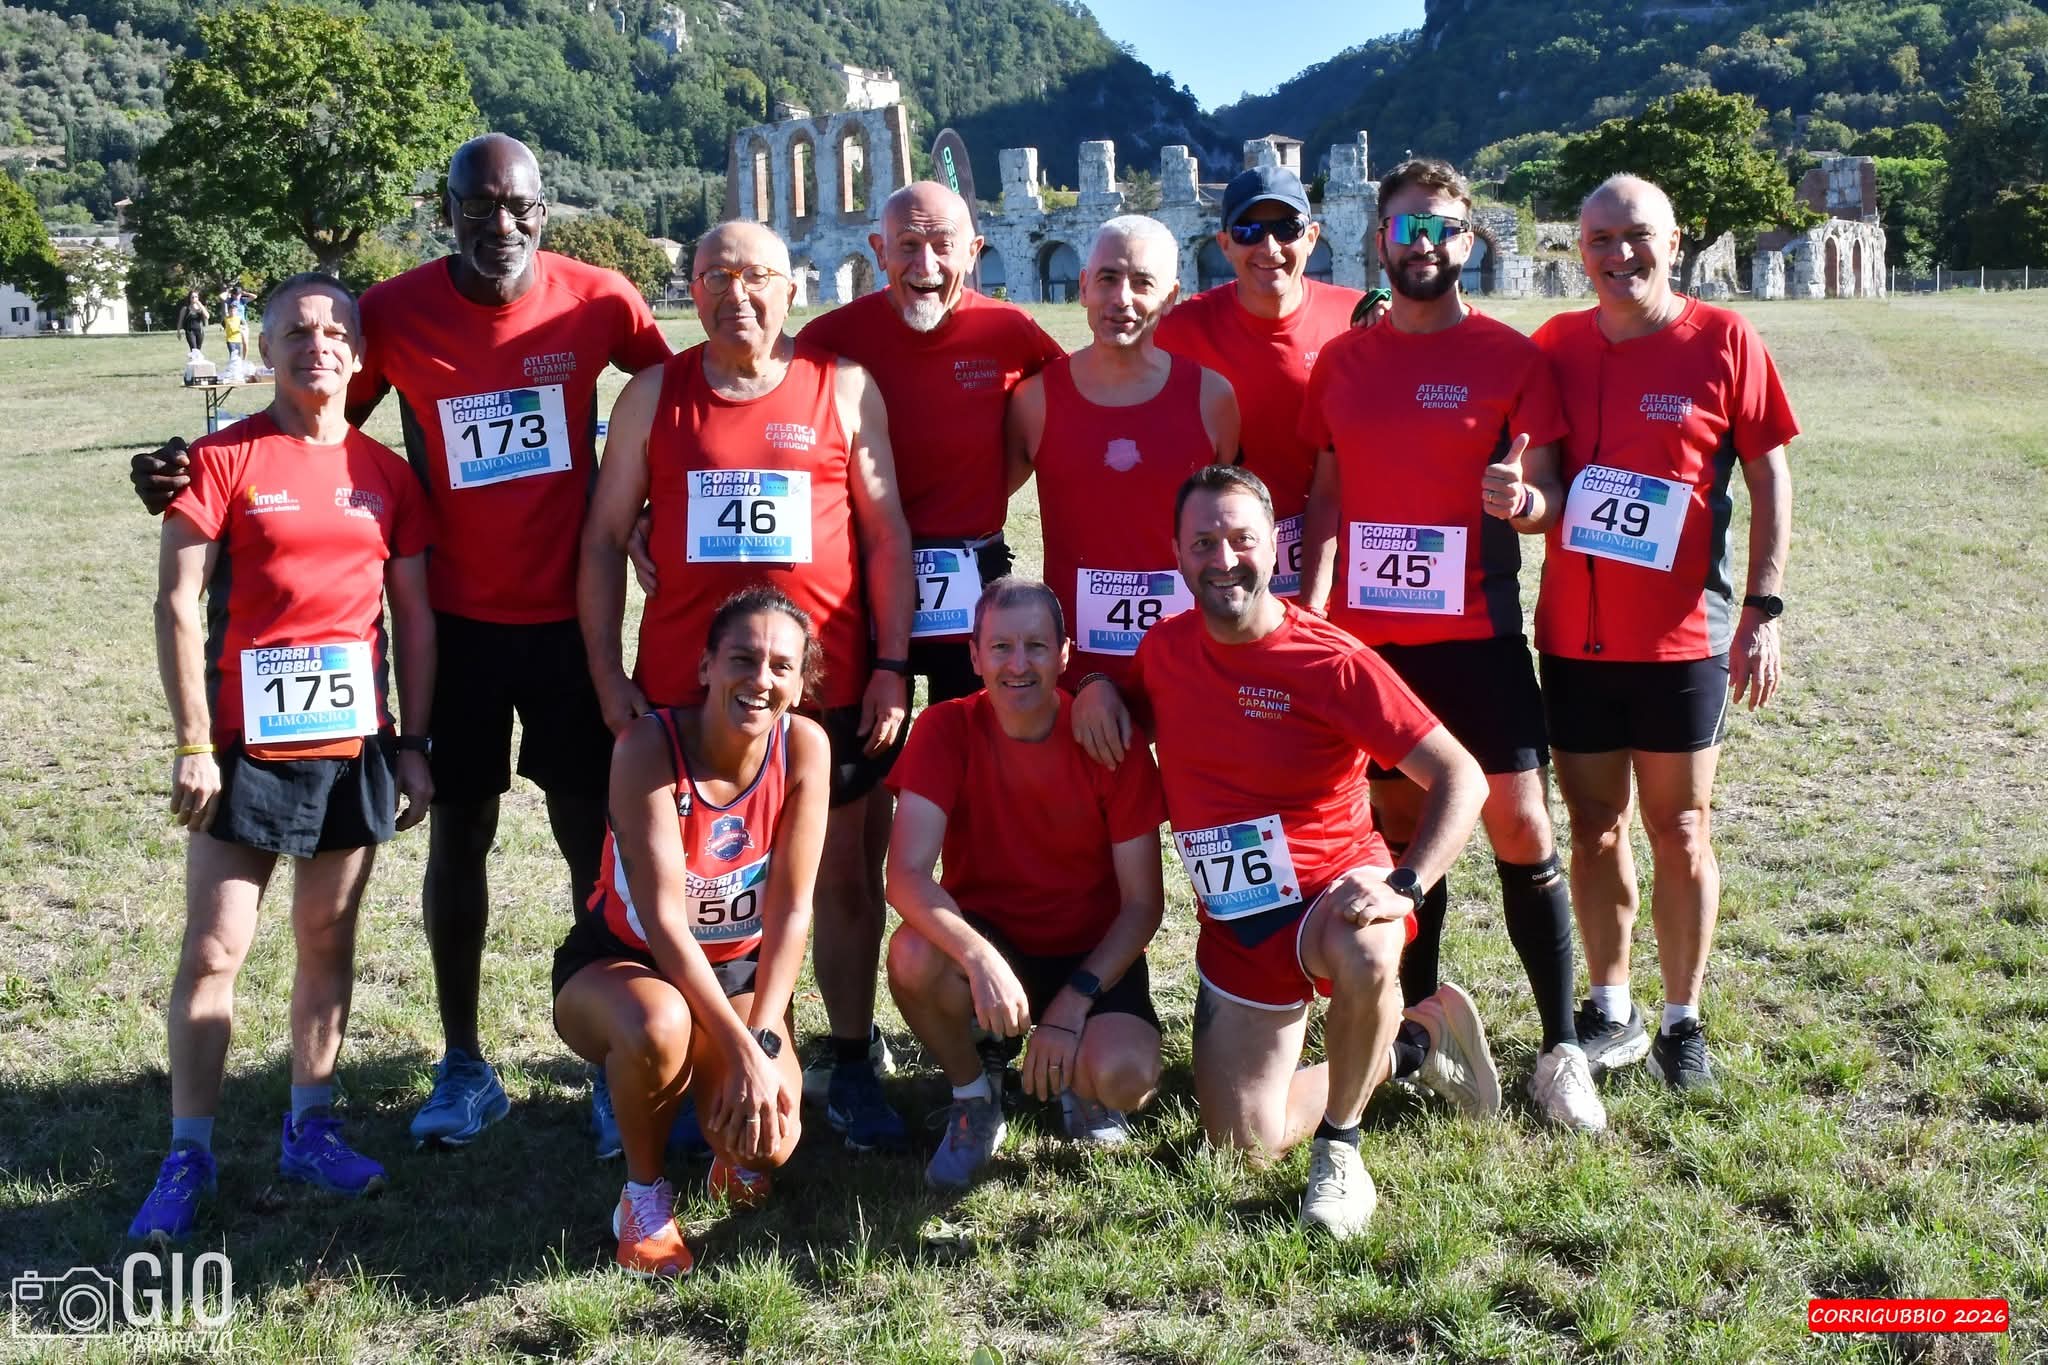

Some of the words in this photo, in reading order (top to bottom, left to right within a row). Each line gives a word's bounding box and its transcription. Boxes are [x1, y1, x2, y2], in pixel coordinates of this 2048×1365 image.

[523, 351, 576, 367] ATLETICA
[523, 361, 577, 377] CAPANNE
[533, 373, 571, 385] PERUGIA
[1417, 383, 1469, 395] ATLETICA
[451, 393, 501, 412] CORRI
[1415, 392, 1468, 403] CAPANNE
[1422, 401, 1459, 409] PERUGIA
[1640, 393, 1693, 406] ATLETICA
[453, 404, 513, 424] GUBBIO
[1639, 403, 1693, 417] CAPANNE
[1645, 412, 1684, 423] PERUGIA
[765, 422, 817, 436] ATLETICA
[460, 414, 548, 460] 173
[765, 431, 817, 445] CAPANNE
[772, 441, 809, 452] PERUGIA
[466, 450, 543, 474] LIMONERO
[701, 472, 750, 485] CORRI
[1586, 466, 1633, 485] CORRI
[335, 487, 383, 503] ATLETICA
[701, 483, 761, 497] GUBBIO
[1582, 478, 1641, 499] GUBBIO
[334, 498, 385, 513] CAPANNE
[717, 499, 777, 535] 46
[1590, 497, 1651, 538] 49
[1276, 519, 1297, 532] RRI
[1362, 525, 1408, 539] CORRI
[706, 536, 785, 548] LIMONERO
[1278, 528, 1303, 542] BBI
[1577, 526, 1650, 551] LIMONERO
[1362, 538, 1417, 551] GUBBIO
[1273, 541, 1303, 575] 6
[912, 563, 936, 574] BIO
[1376, 554, 1432, 589] 45
[1091, 571, 1139, 585] CORRI
[1091, 583, 1149, 596] GUBBIO
[1366, 587, 1438, 601] LIMONERO
[920, 610, 961, 622] NERO
[1106, 598, 1163, 631] 48
[1096, 631, 1145, 642] LIMON
[257, 647, 310, 662] CORRI
[257, 659, 323, 675] GUBBIO
[263, 672, 355, 713] 175
[1237, 685, 1291, 702] ATLETICA
[1238, 697, 1291, 712] CAPANNE
[267, 709, 350, 728] LIMONERO
[1244, 709, 1282, 720] PERUGIA
[1183, 829, 1219, 844] CORRI
[1186, 840, 1232, 857] GUBBIO
[1194, 849, 1273, 894] 176
[697, 889, 757, 926] 50
[692, 920, 757, 935] IMONER
